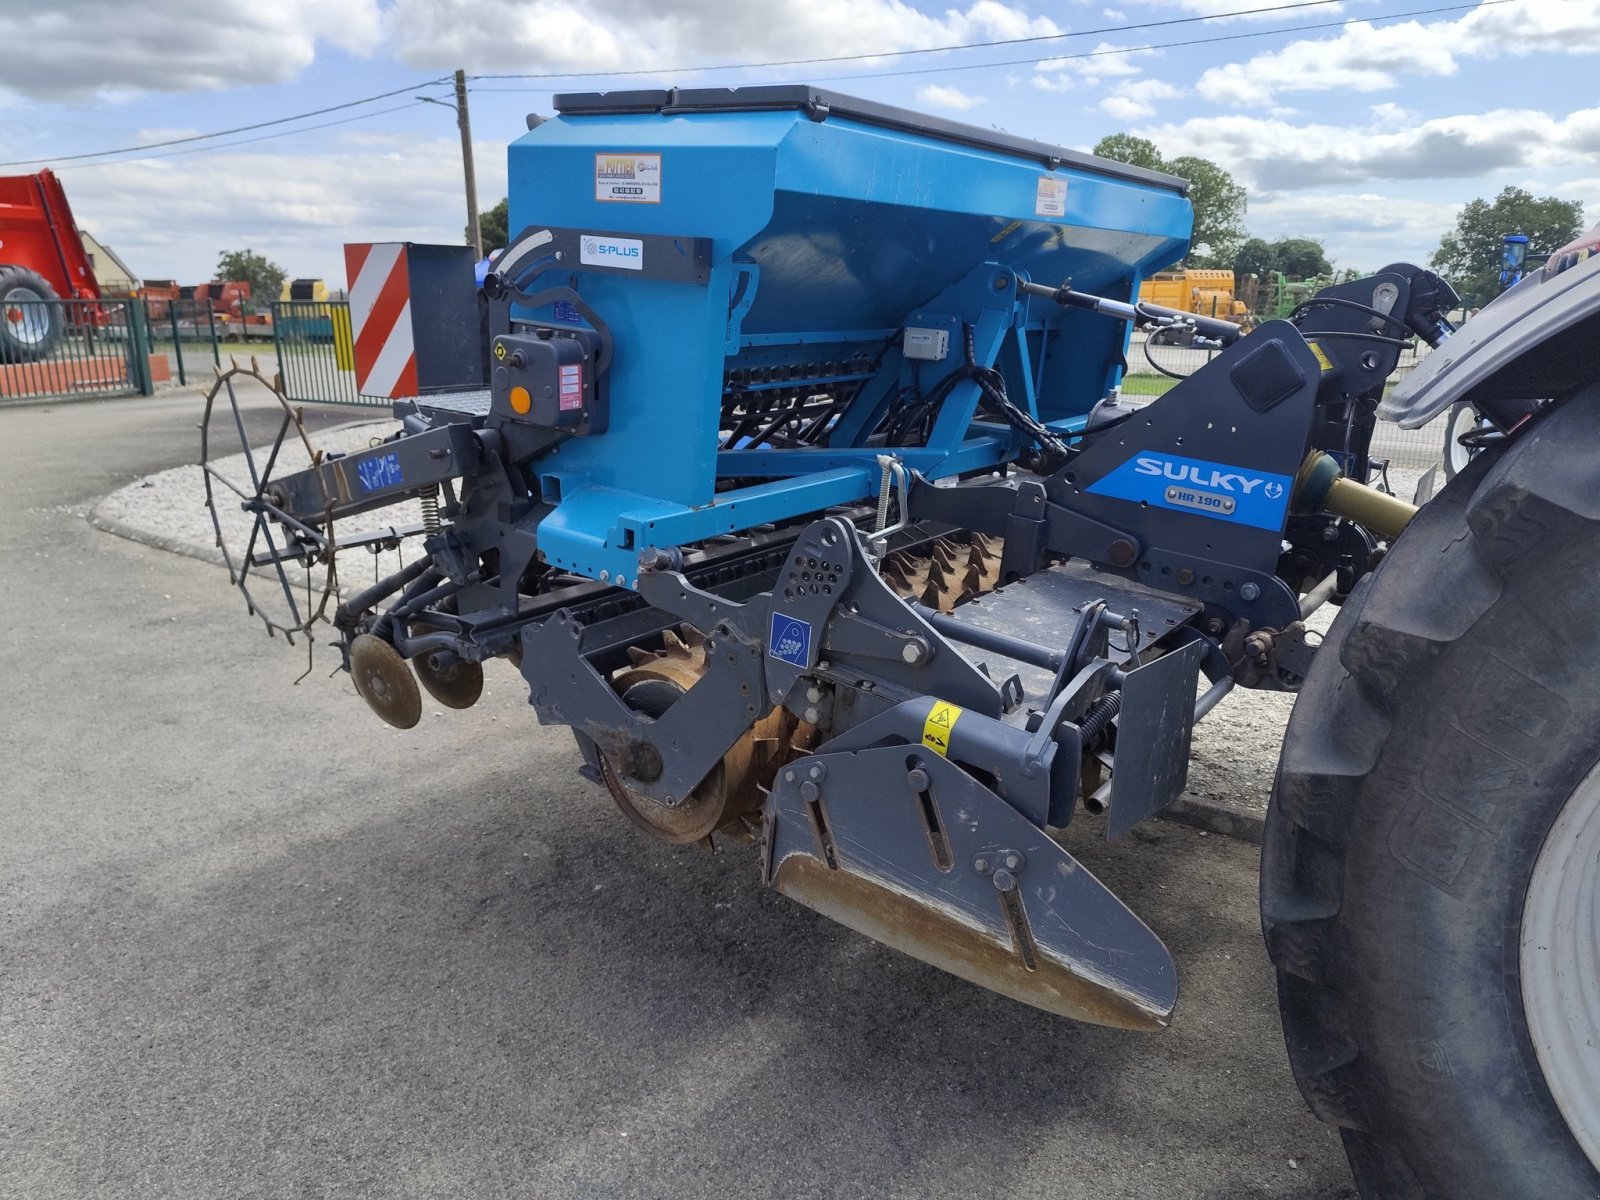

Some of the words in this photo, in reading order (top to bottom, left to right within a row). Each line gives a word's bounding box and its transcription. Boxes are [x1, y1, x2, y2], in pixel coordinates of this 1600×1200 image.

[598, 245, 639, 257] S-PLUS
[1134, 457, 1264, 495] SULKY
[1177, 491, 1194, 503] HR
[1197, 495, 1221, 508] 190
